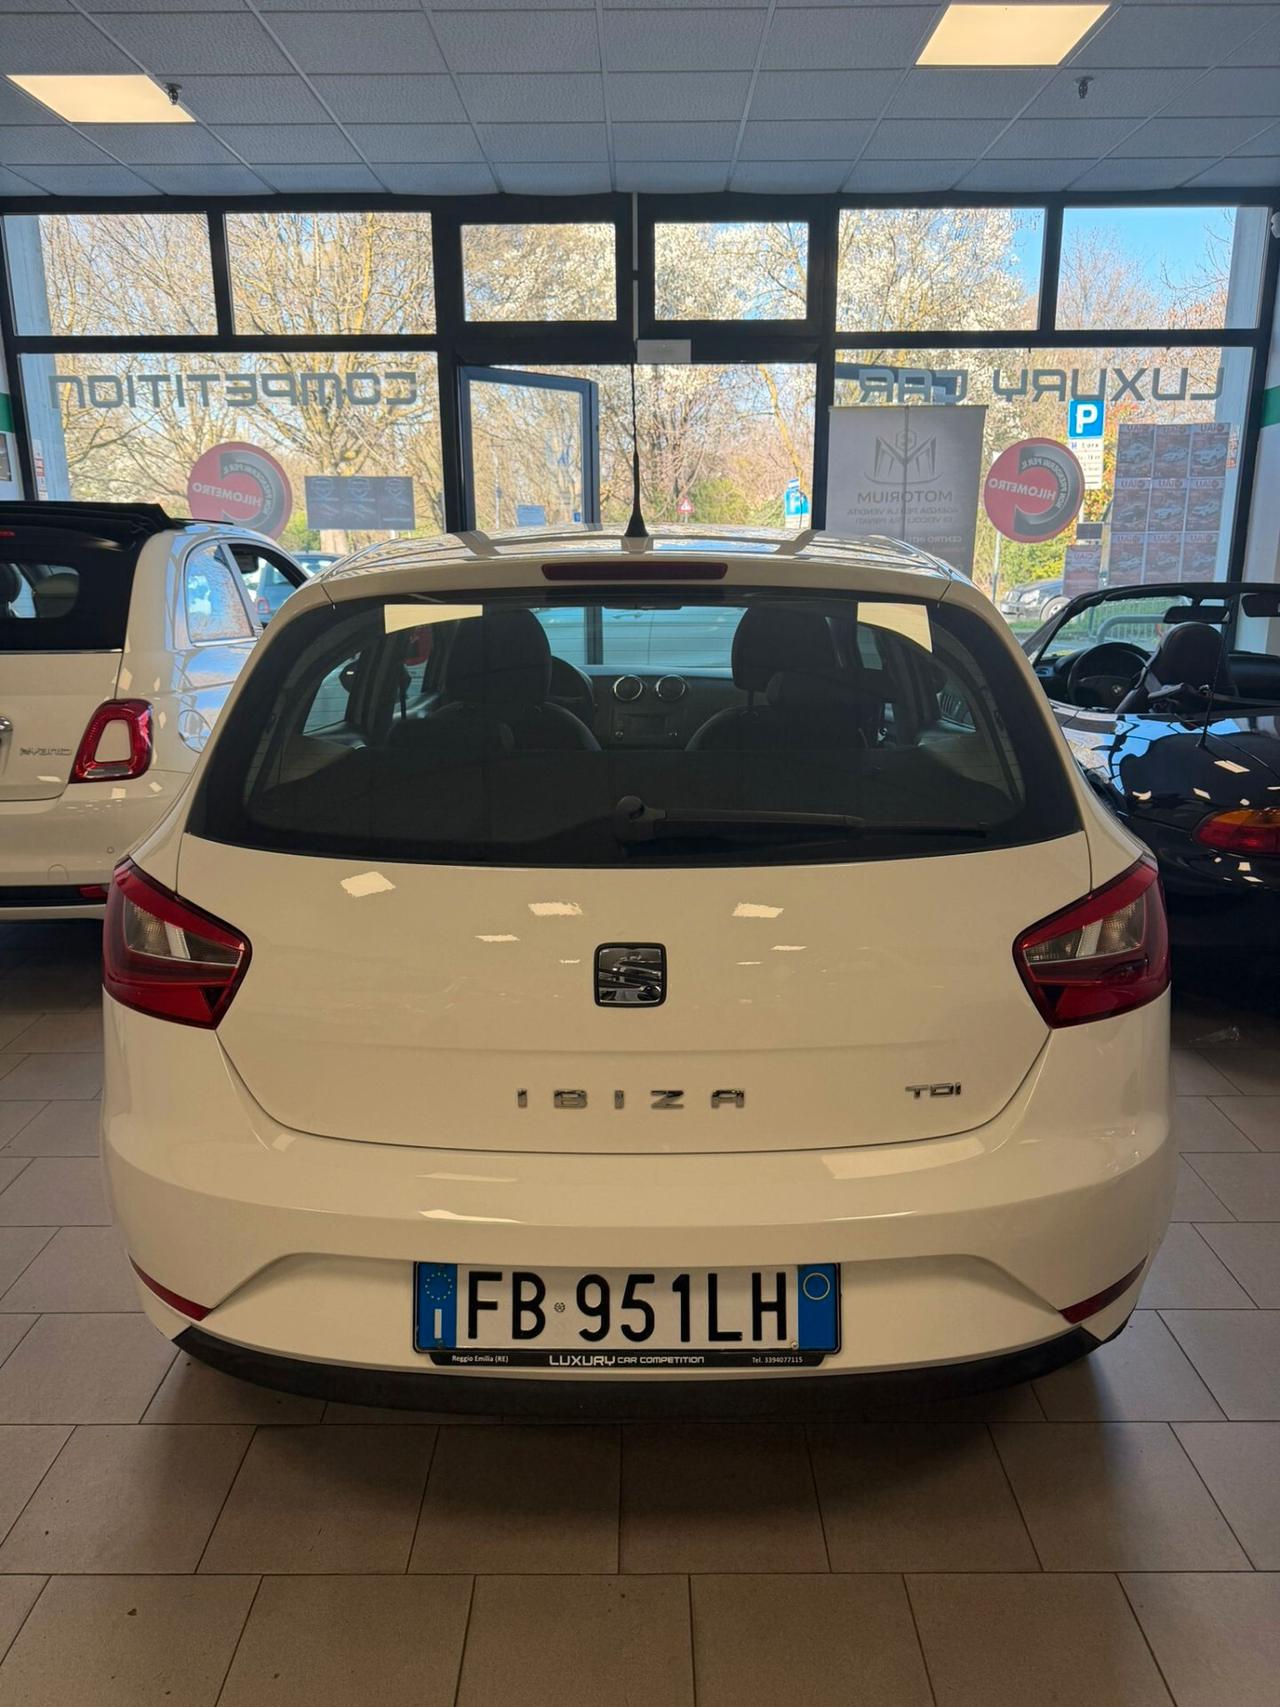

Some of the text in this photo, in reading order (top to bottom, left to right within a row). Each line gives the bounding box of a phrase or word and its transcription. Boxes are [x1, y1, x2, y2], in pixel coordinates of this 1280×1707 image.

[1075, 403, 1098, 434] P
[905, 1082, 962, 1099] TDI
[516, 1089, 745, 1109] IBIZA
[452, 1355, 473, 1363] Reggio
[549, 1354, 705, 1367] LUXURY CAR COMPETITION
[752, 1356, 763, 1364] Tel.
